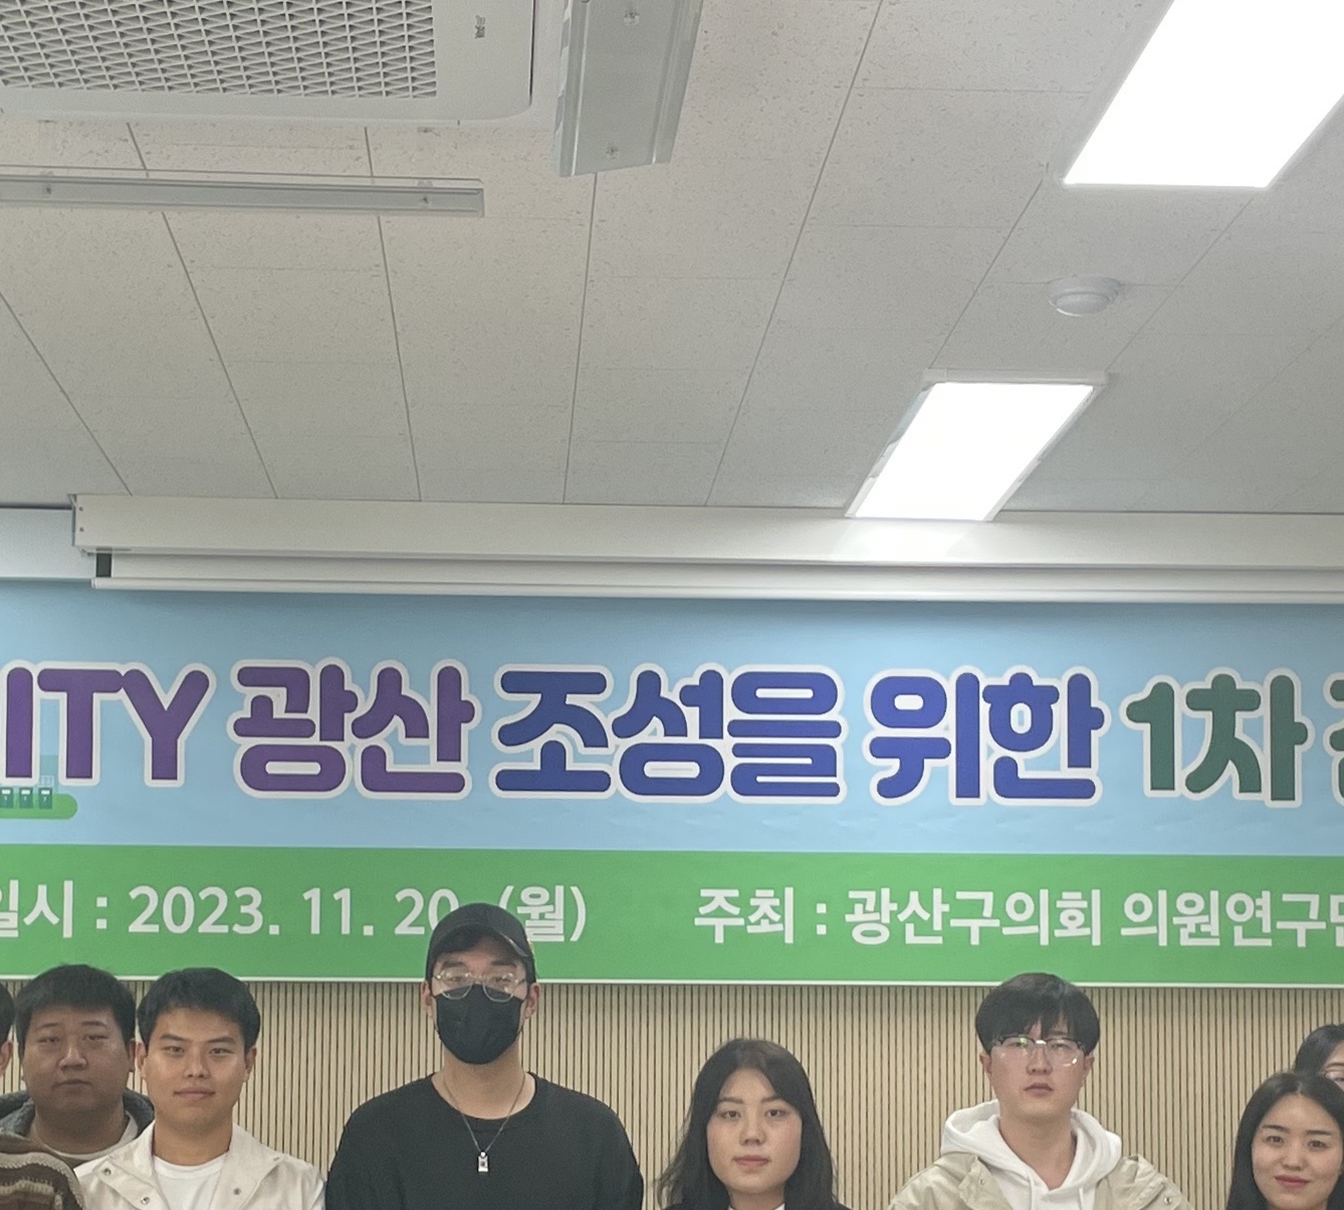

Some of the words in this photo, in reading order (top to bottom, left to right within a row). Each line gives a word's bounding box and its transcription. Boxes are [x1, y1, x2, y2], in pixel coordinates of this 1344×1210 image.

[233, 665, 476, 796] 광산
[495, 668, 842, 799] 조성을
[869, 671, 1105, 801] 위한
[1127, 673, 1309, 803] 1차
[128, 886, 280, 937] 2023.
[303, 887, 375, 936] 11.
[694, 886, 796, 945] 주최
[843, 887, 1104, 948] 광산구의회
